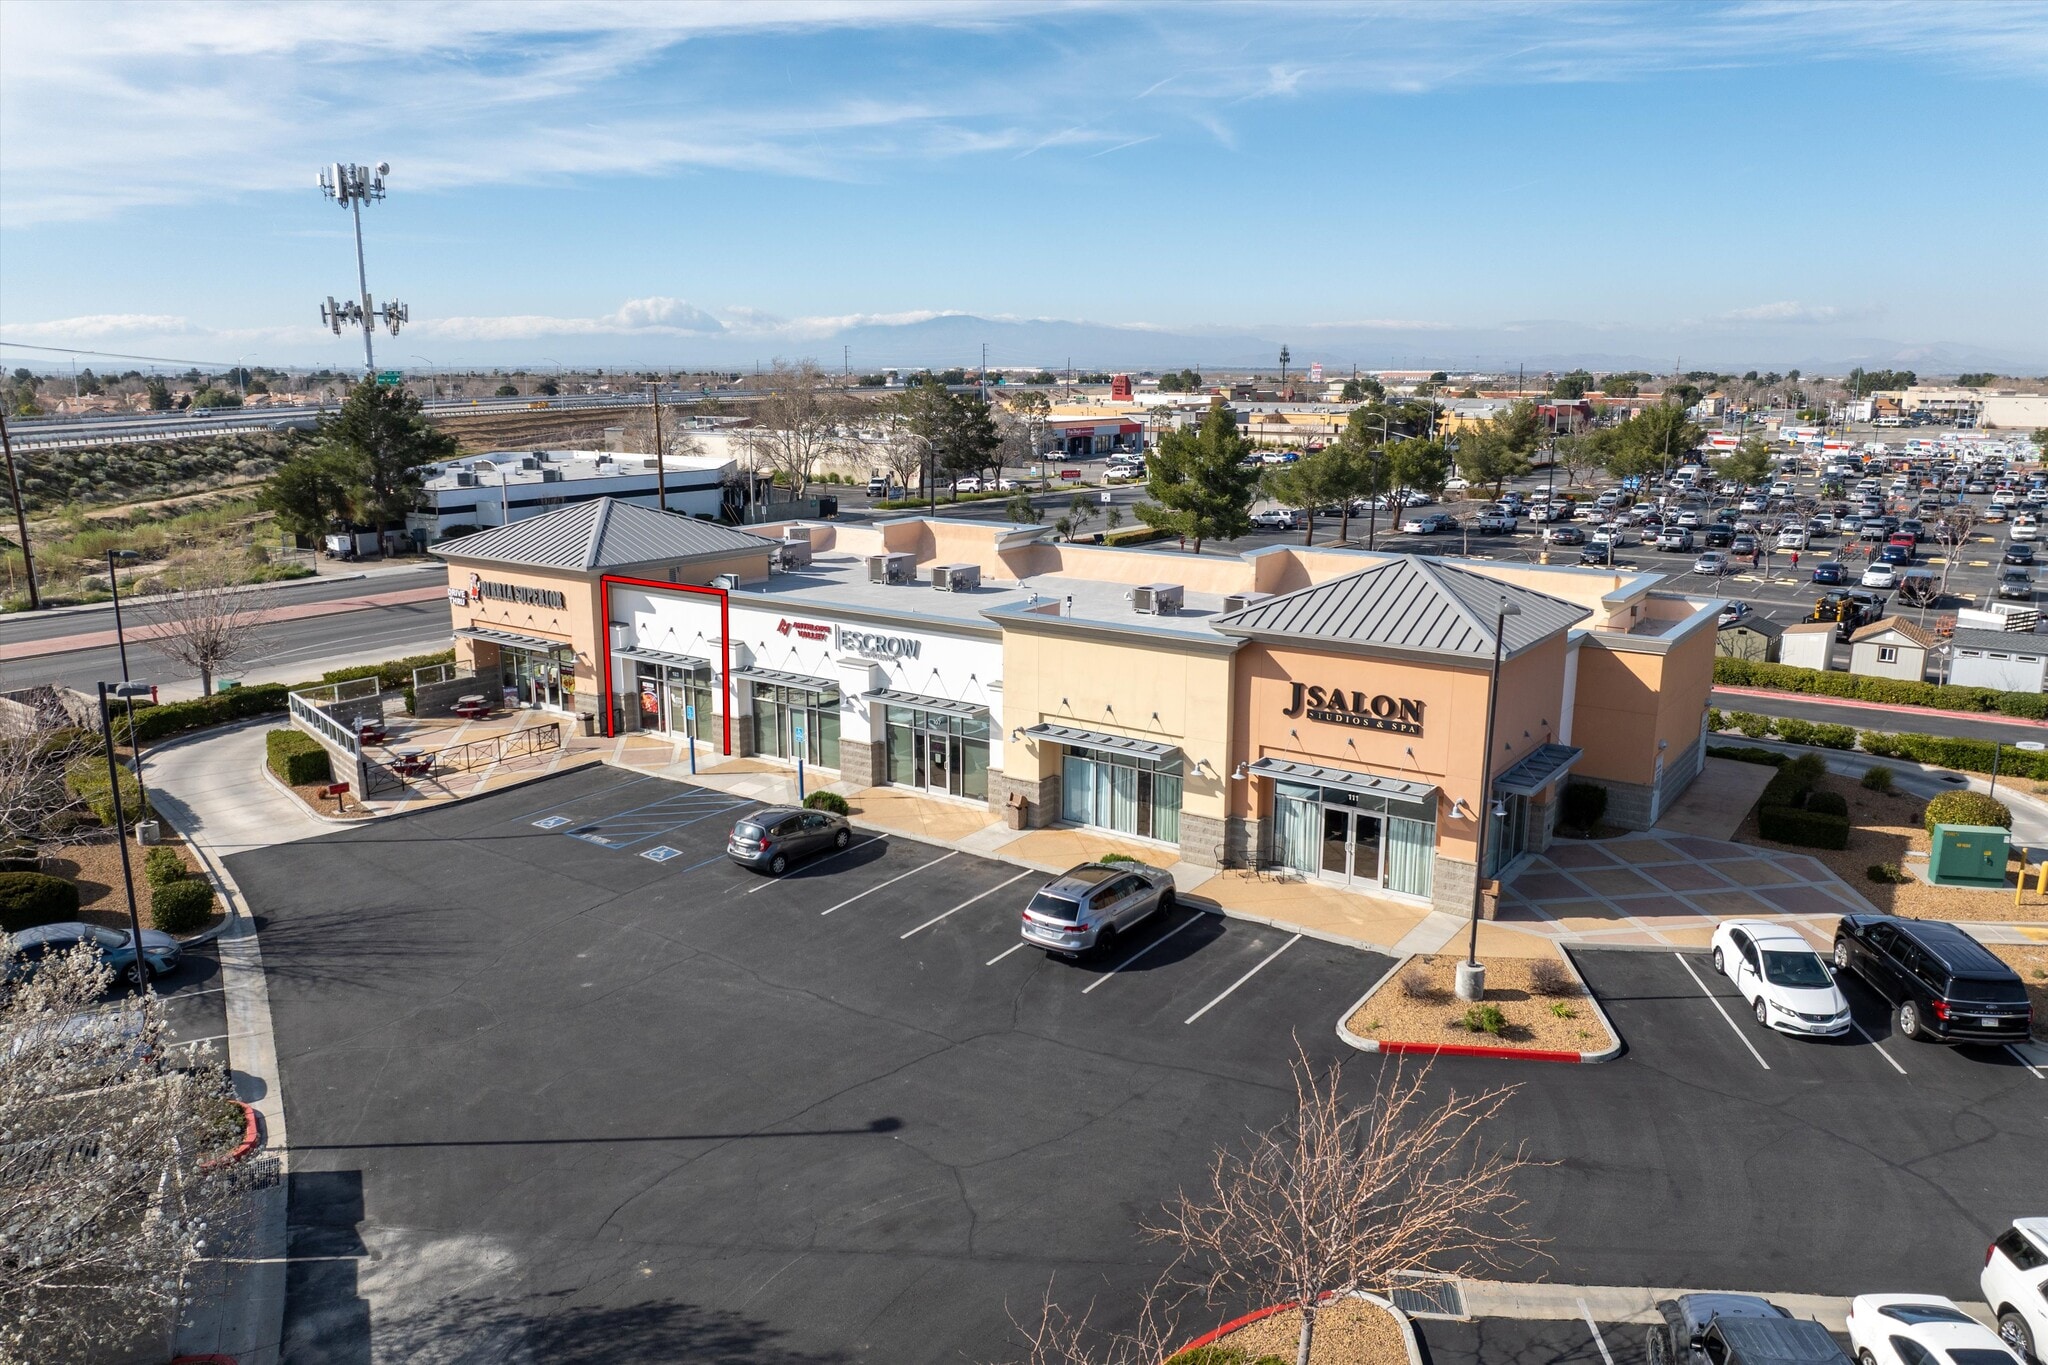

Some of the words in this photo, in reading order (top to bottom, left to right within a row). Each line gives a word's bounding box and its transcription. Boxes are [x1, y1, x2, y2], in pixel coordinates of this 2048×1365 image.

[447, 588, 466, 598] DRIVE
[480, 581, 513, 602] BIRRIA
[514, 585, 563, 608] SUPERIOR
[448, 596, 466, 606] THRU
[798, 630, 825, 641] VALLEY
[841, 630, 919, 658] ESCROW
[1308, 711, 1369, 726] STUDIOS
[1391, 722, 1415, 733] SPA
[1348, 793, 1359, 802] 111
